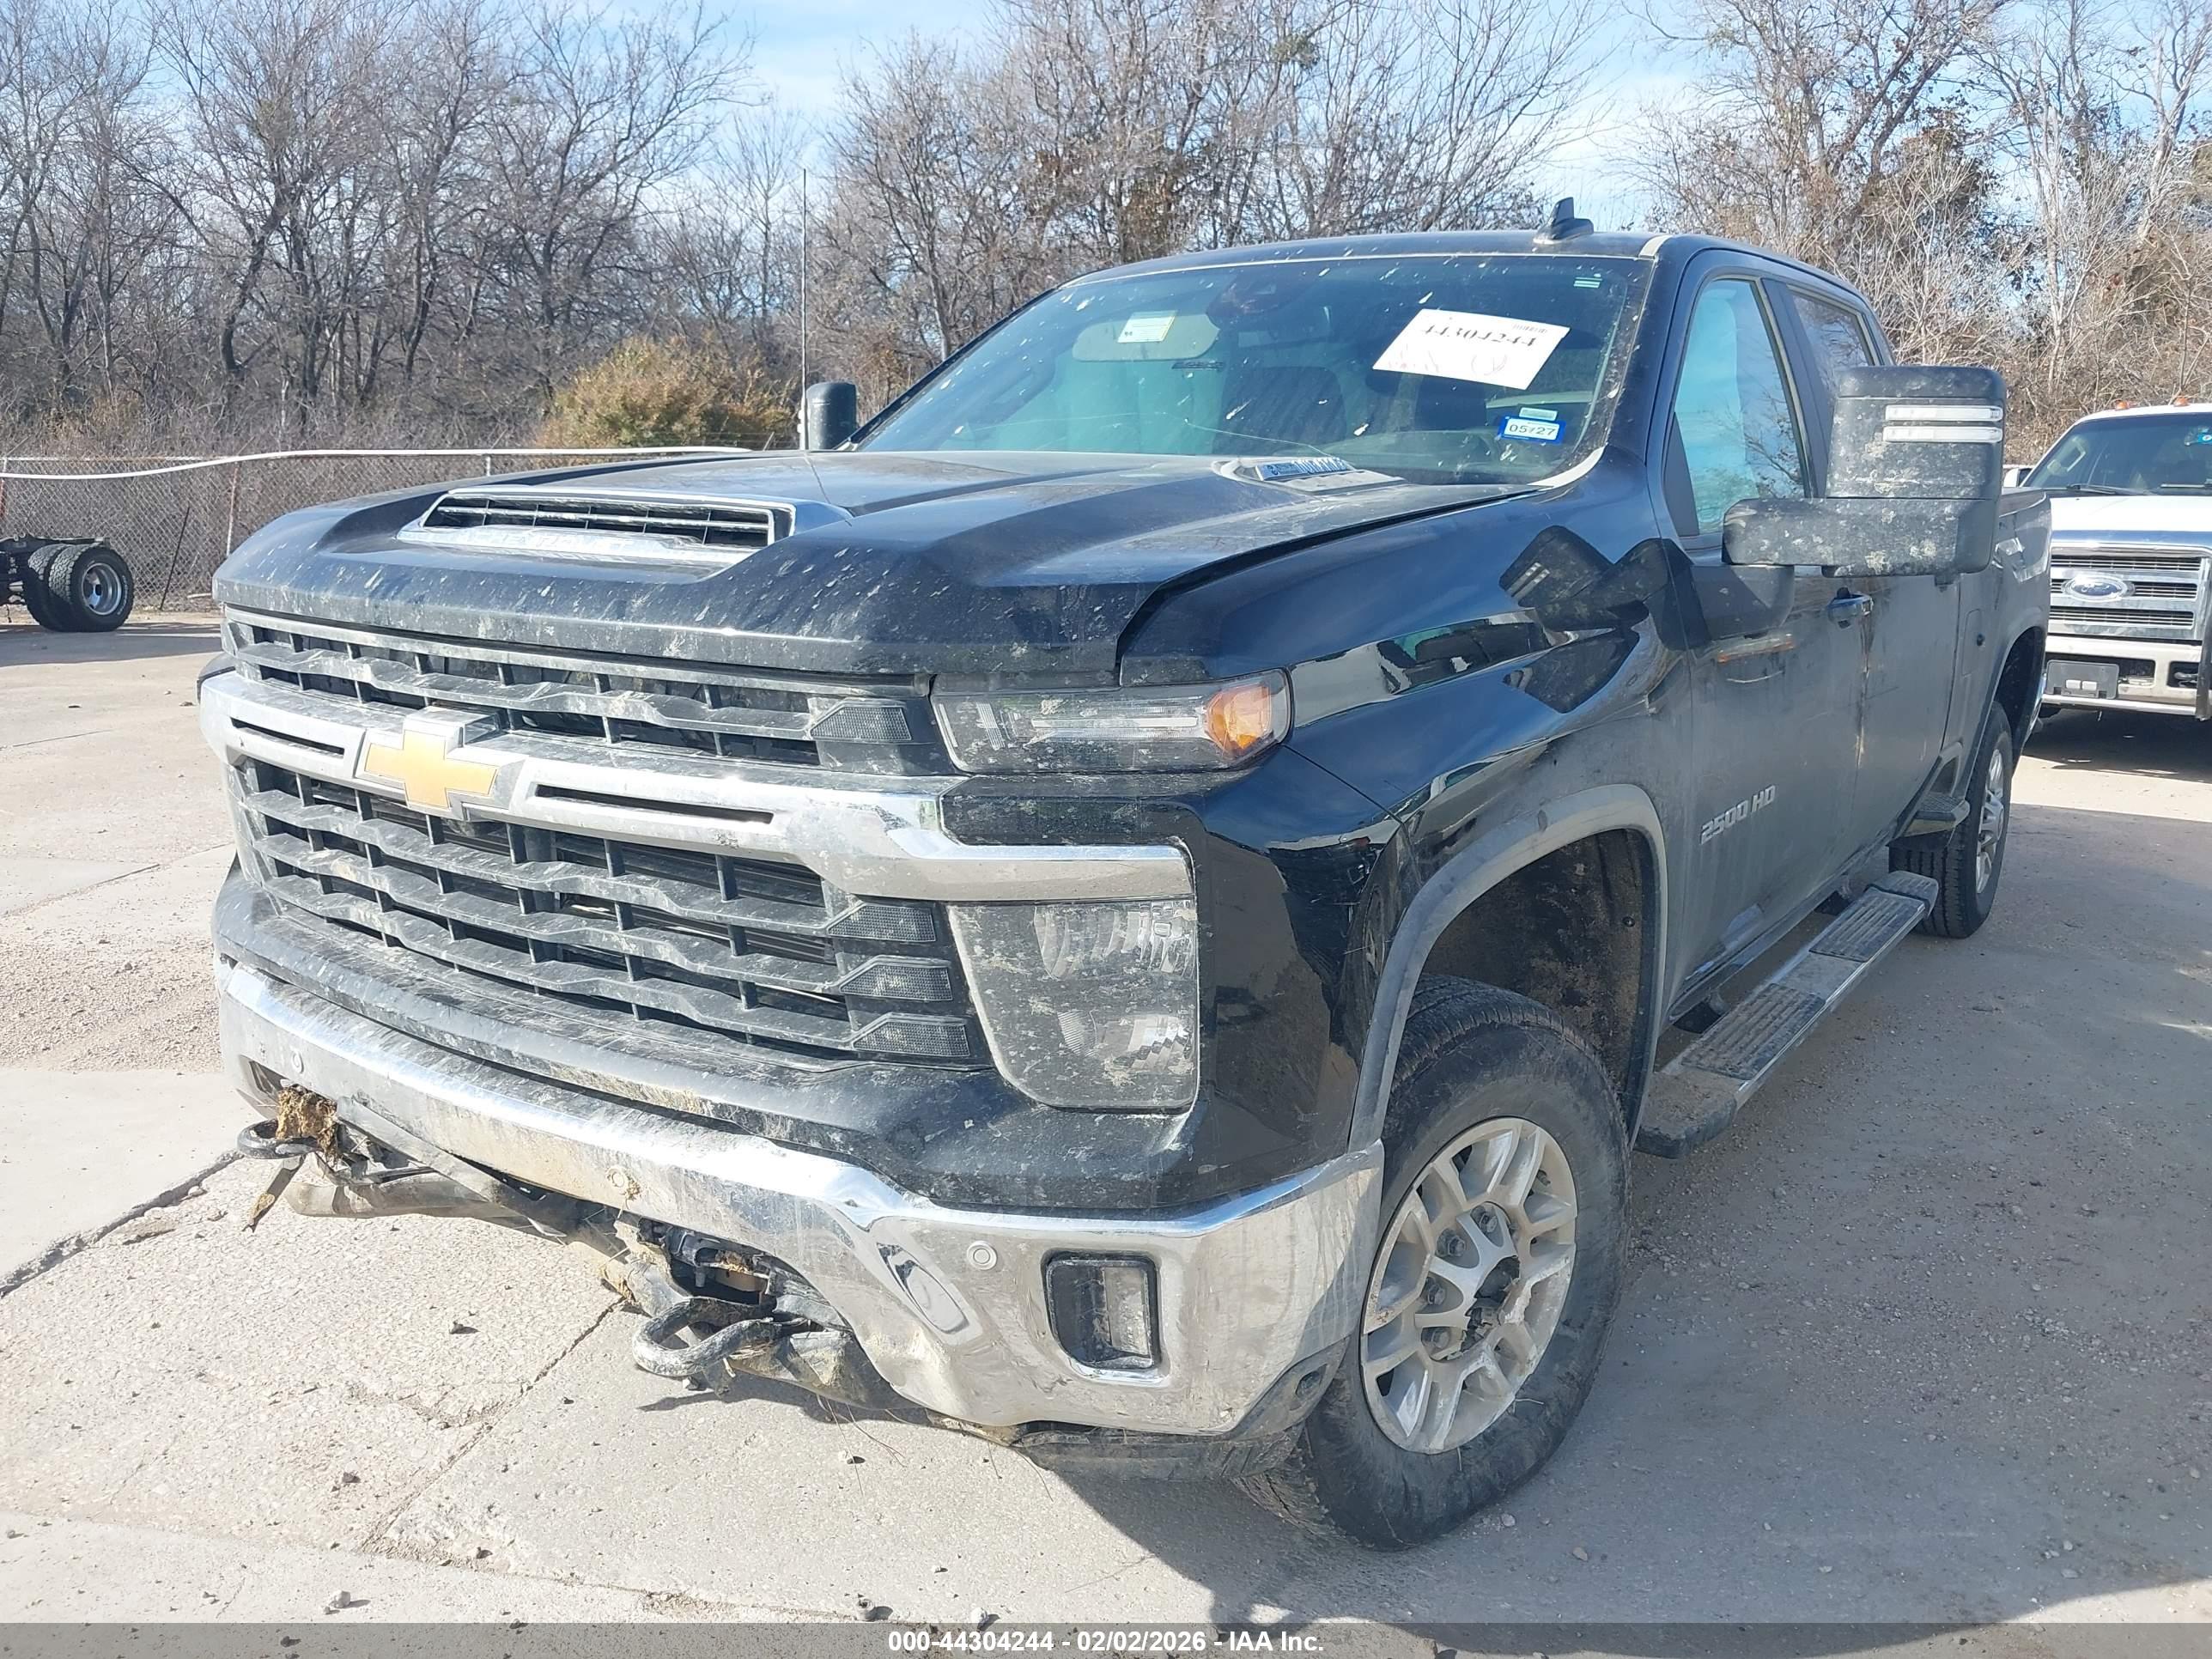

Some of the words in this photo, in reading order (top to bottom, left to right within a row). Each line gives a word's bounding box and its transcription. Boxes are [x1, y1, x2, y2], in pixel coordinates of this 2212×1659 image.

[1509, 422, 1558, 436] 05/27
[1699, 799, 1749, 845] 2500
[1751, 784, 1777, 813] HD
